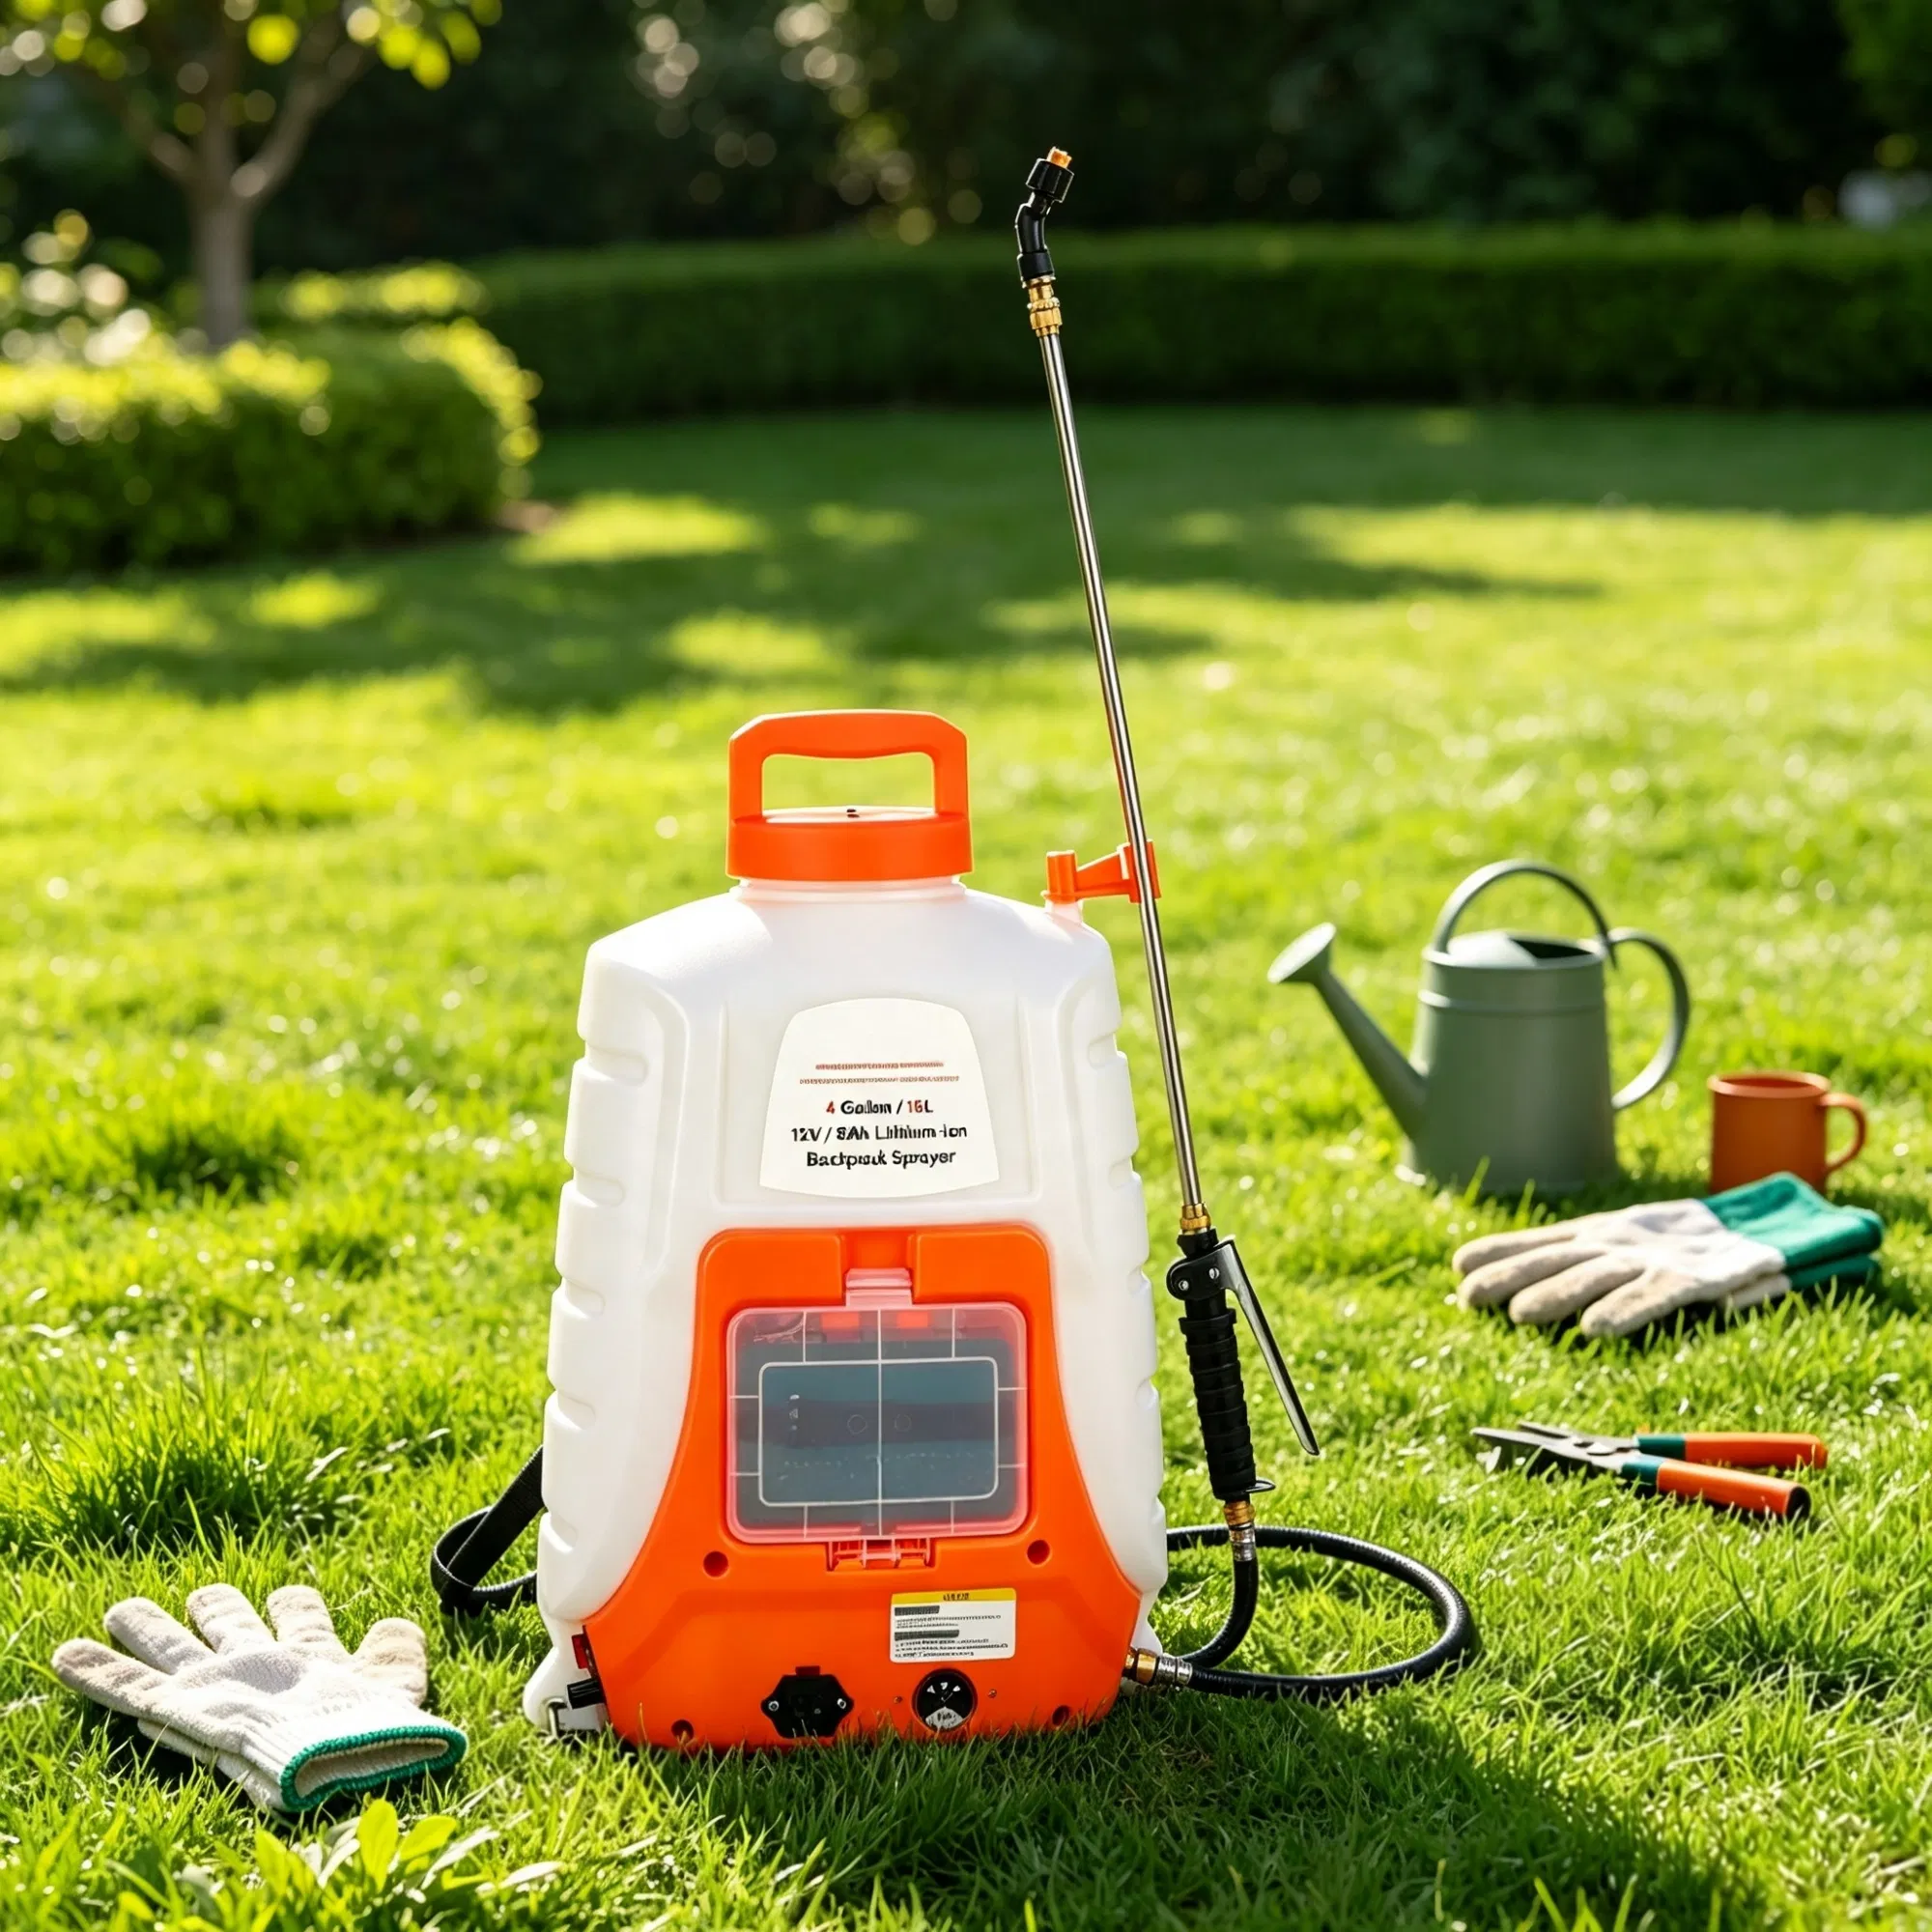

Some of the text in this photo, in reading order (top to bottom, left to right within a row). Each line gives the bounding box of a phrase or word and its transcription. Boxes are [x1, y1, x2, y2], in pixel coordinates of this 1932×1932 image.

[826, 1100, 836, 1115] 4
[896, 1099, 903, 1115] /
[823, 1126, 833, 1145] /
